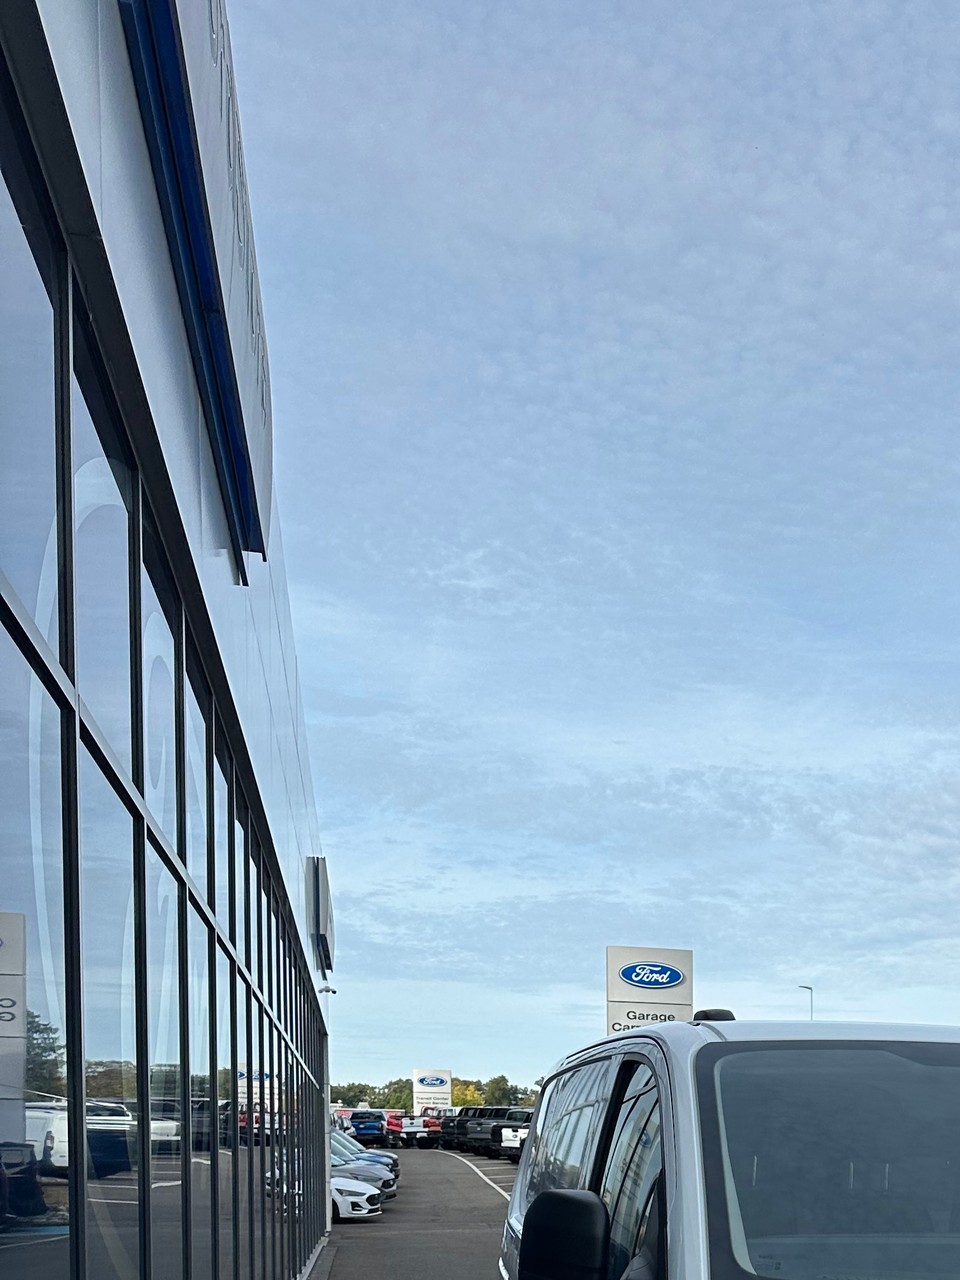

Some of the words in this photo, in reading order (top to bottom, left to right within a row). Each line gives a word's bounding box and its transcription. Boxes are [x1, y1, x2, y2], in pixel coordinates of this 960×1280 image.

[632, 965, 671, 983] Ford
[626, 1010, 676, 1022] Garage
[611, 1022, 641, 1032] Car
